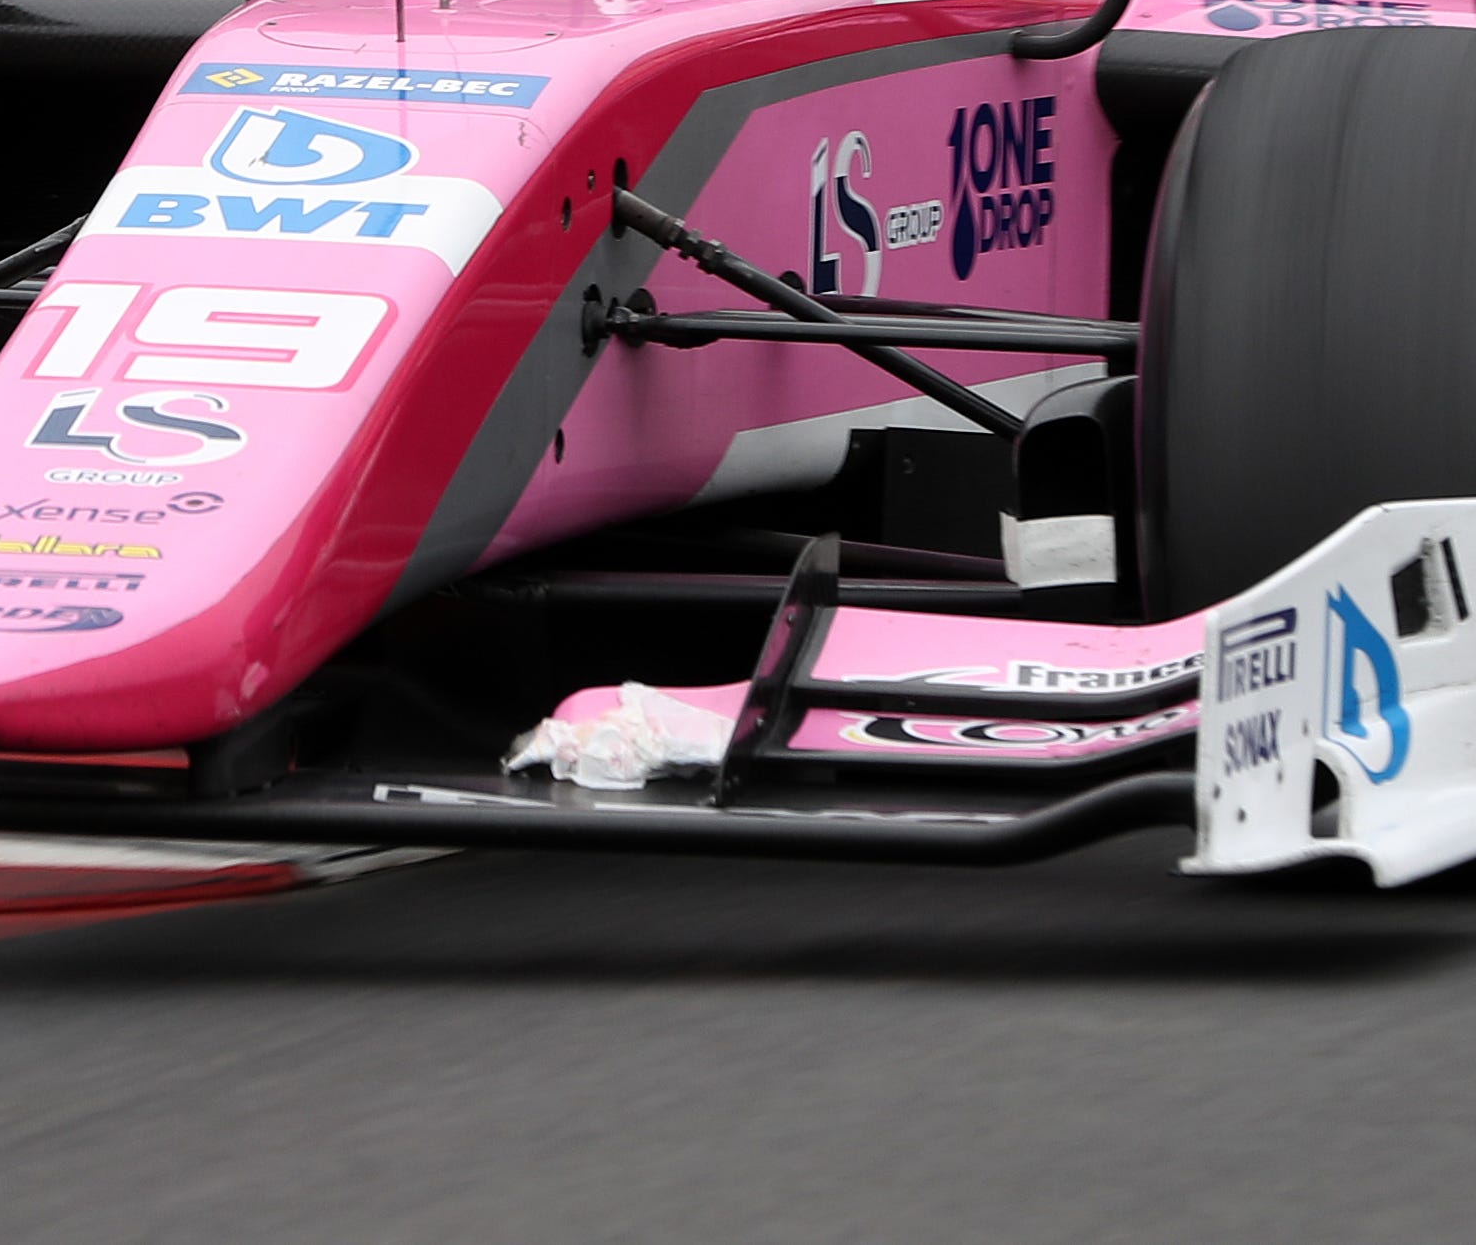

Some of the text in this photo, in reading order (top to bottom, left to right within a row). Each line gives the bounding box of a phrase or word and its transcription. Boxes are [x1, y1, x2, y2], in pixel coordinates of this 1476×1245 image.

[269, 84, 320, 95] FAYAT
[275, 72, 521, 98] RAZEL-BEC
[116, 193, 431, 239] BWT
[886, 201, 944, 248] GROUP
[979, 188, 1053, 254] DROP
[32, 280, 394, 391] 19
[46, 469, 182, 487] GROUP
[1016, 651, 1206, 689] France
[1218, 606, 1298, 703] PIRELLI
[1224, 709, 1282, 777] SONAX
